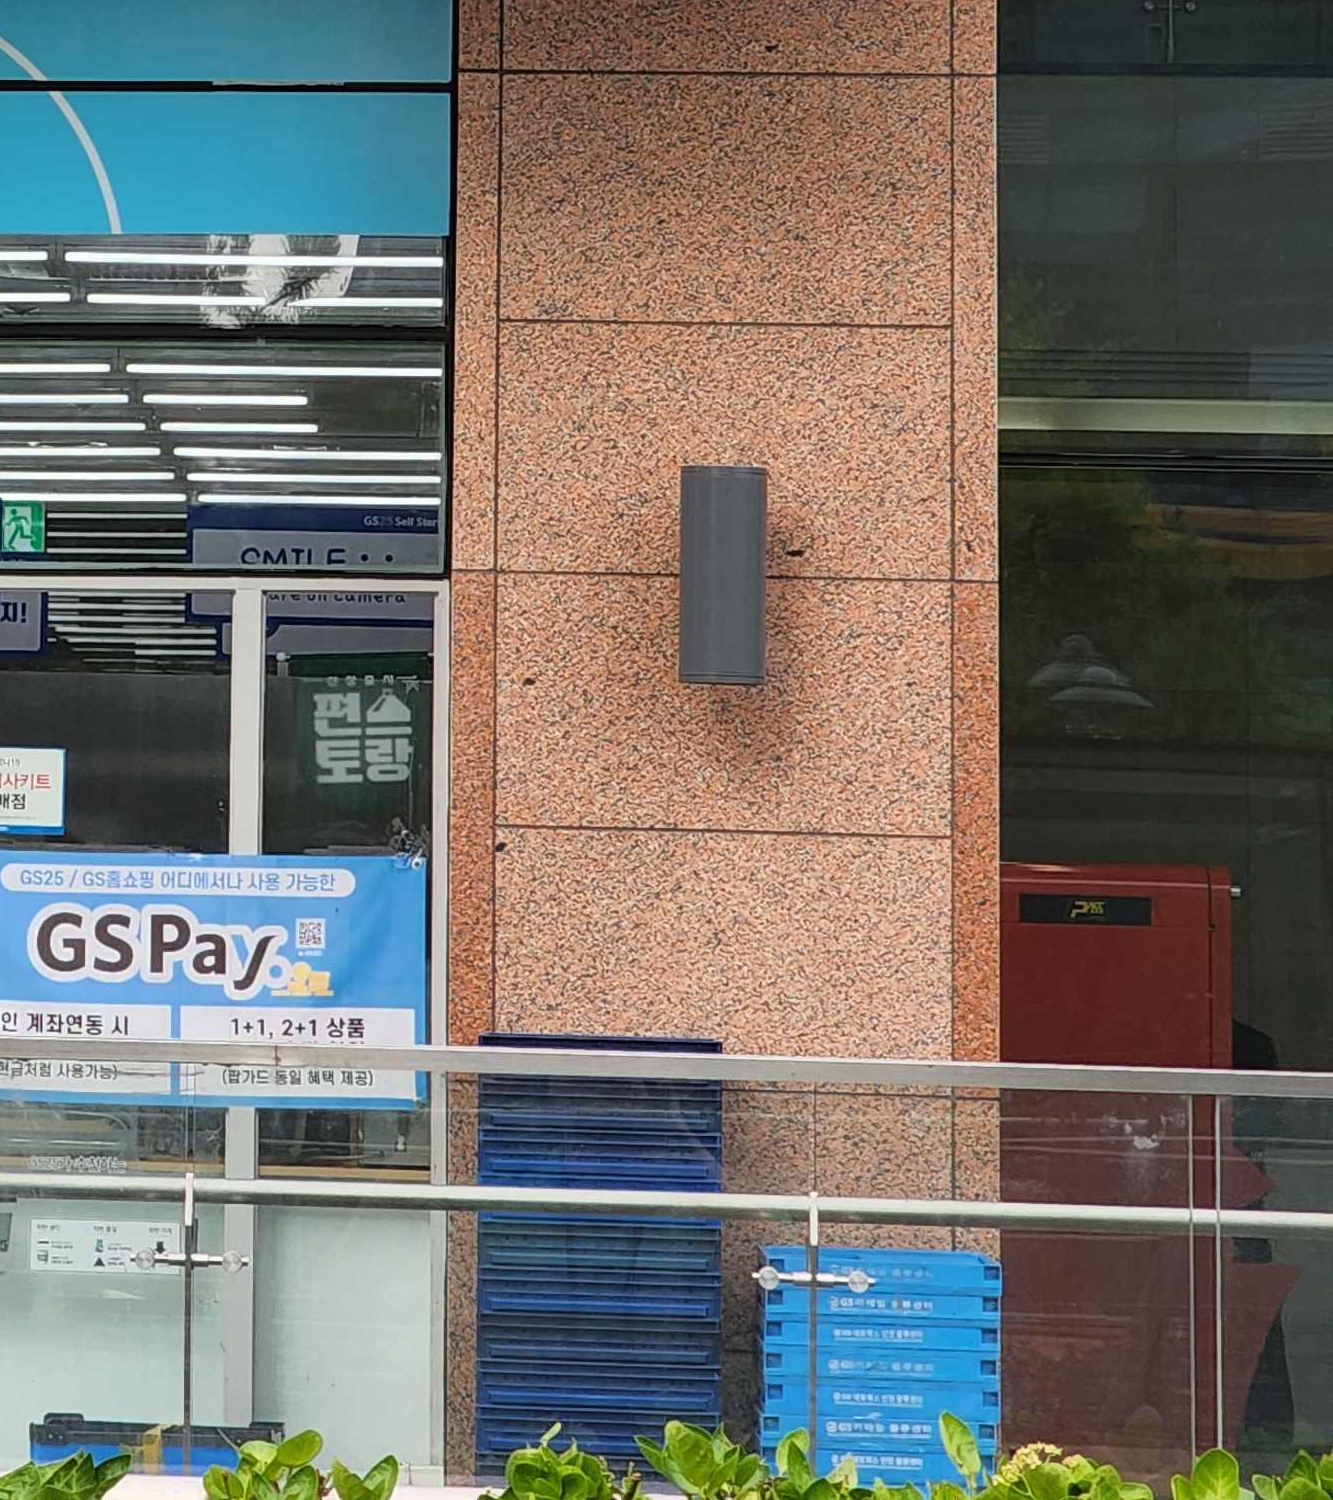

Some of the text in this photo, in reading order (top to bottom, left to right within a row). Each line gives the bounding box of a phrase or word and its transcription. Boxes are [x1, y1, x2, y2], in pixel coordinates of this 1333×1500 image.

[416, 516, 439, 528] Stor
[20, 869, 64, 887] GS25
[83, 870, 155, 889] GS홈쇼핑
[161, 871, 243, 891] 어디에서나
[247, 873, 281, 891] 사용
[285, 874, 337, 892] 가능한
[26, 1013, 103, 1036] 계좌연동
[111, 1016, 129, 1036] 시
[230, 1018, 366, 1040] 1+1, 2+1 상품
[57, 1064, 118, 1080] 사용가능)
[274, 1070, 302, 1087] 동일
[307, 1071, 335, 1087] 혜택
[340, 1071, 374, 1088] 제공)
